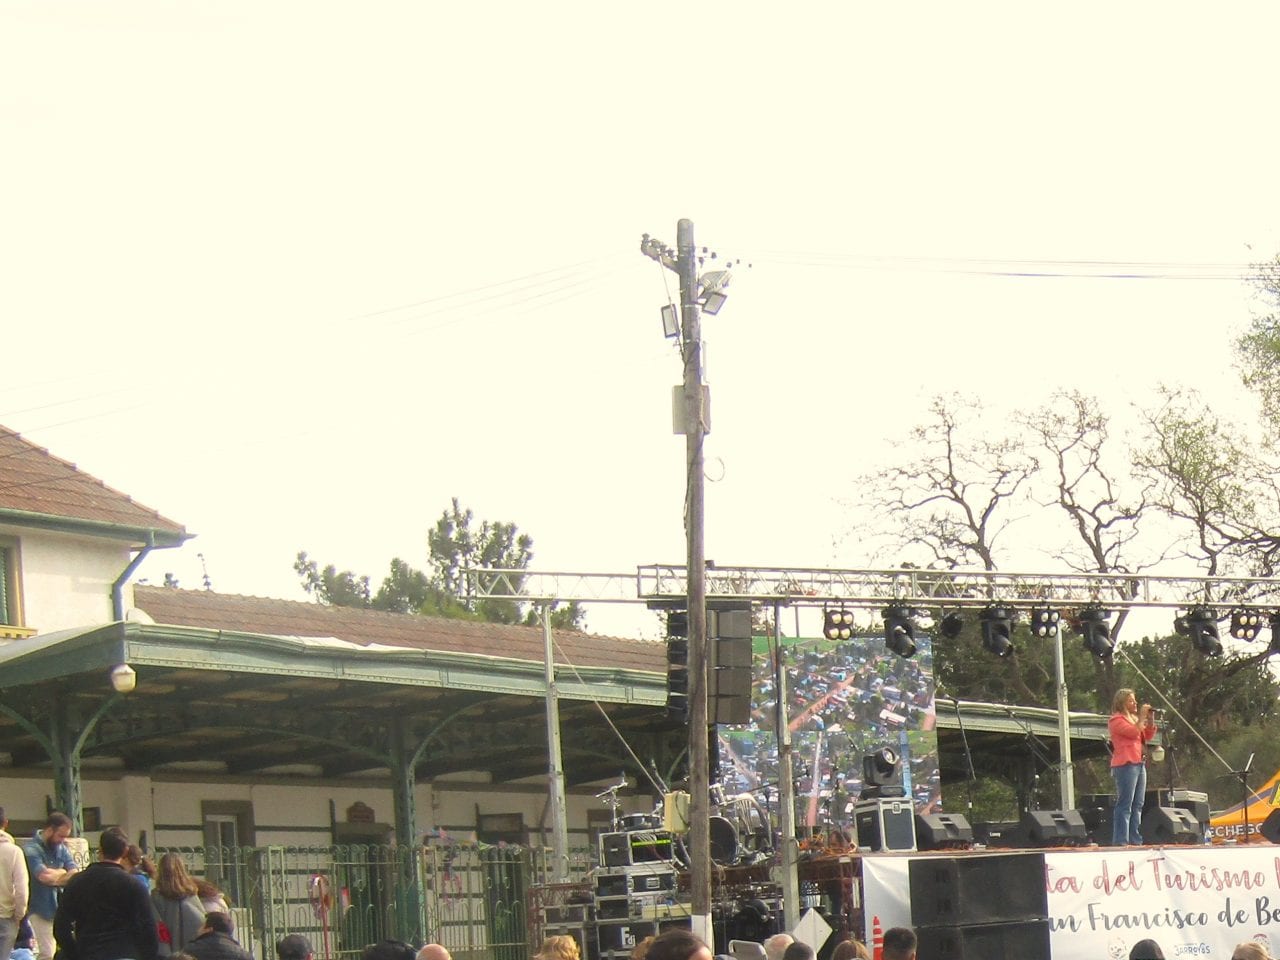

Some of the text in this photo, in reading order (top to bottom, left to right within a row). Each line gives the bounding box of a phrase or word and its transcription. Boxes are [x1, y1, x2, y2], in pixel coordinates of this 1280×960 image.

[1093, 859, 1143, 896] del
[1147, 857, 1265, 891] Turismo
[1087, 902, 1208, 931] Francisco
[1217, 897, 1249, 927] de
